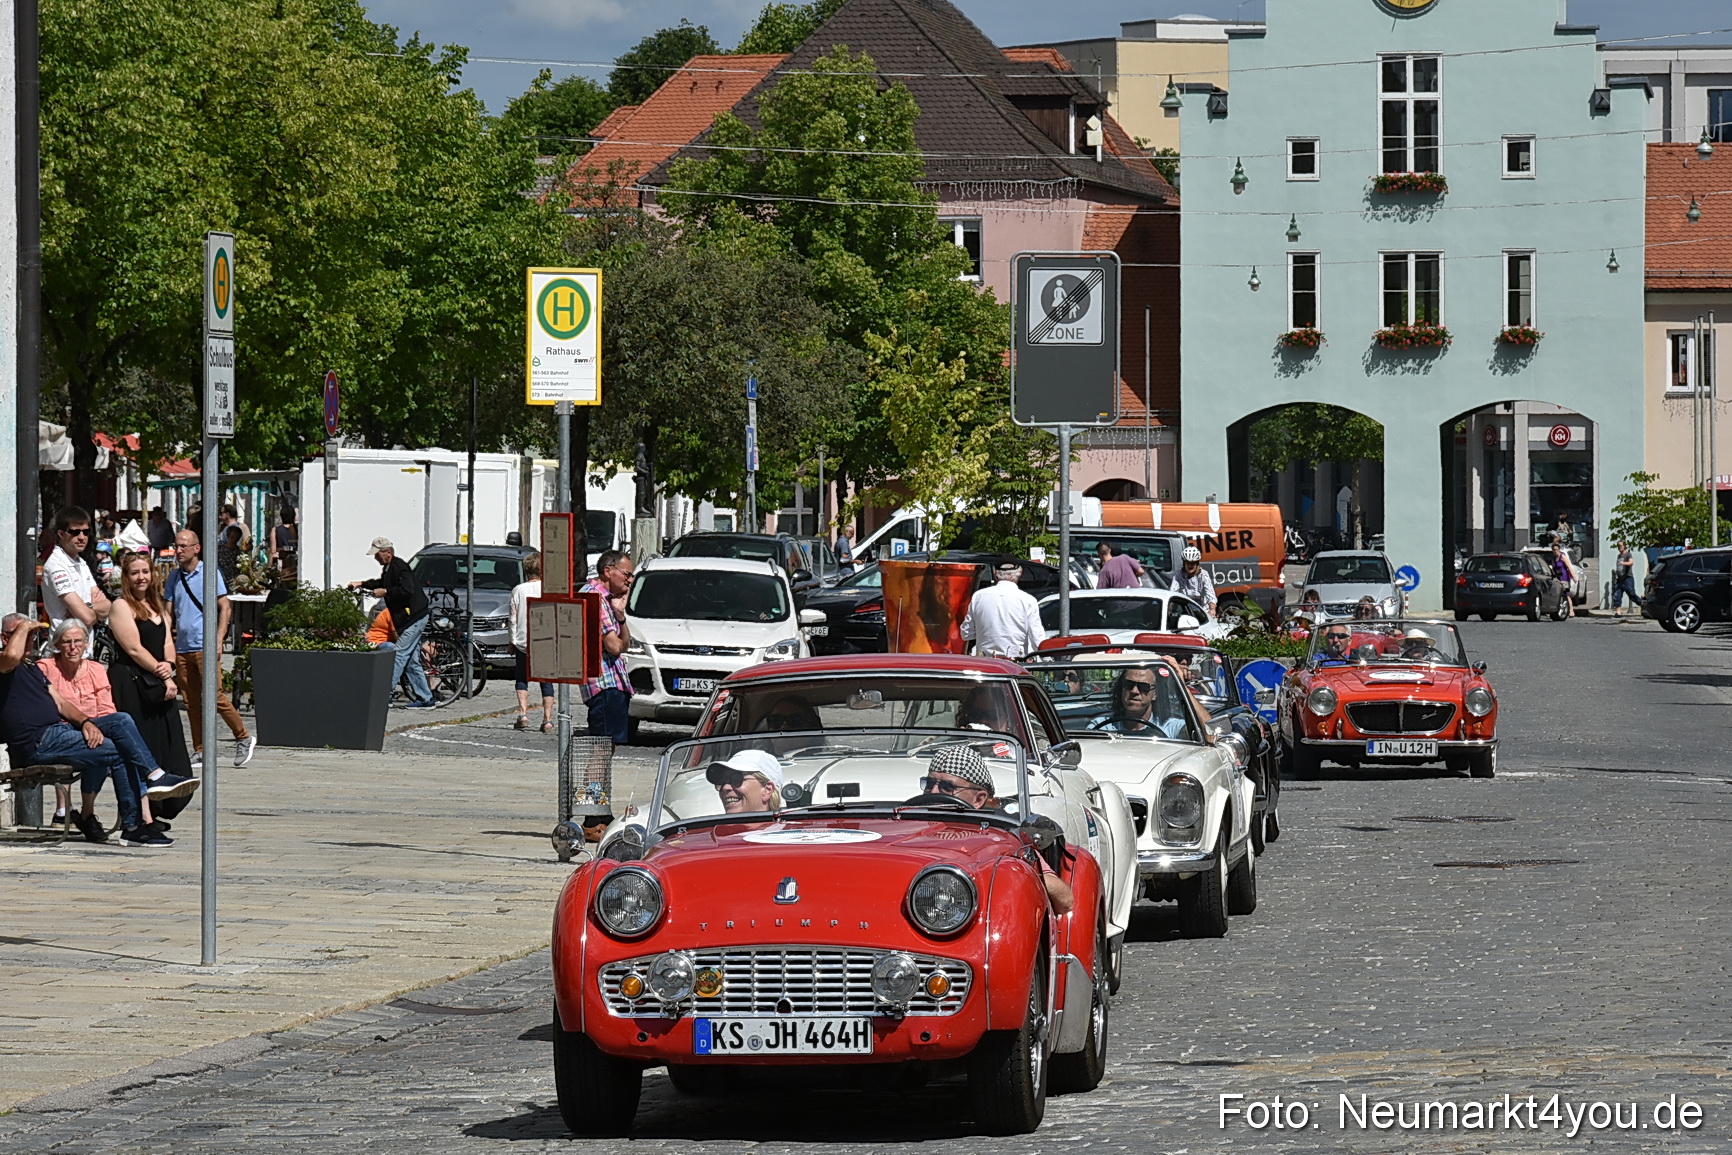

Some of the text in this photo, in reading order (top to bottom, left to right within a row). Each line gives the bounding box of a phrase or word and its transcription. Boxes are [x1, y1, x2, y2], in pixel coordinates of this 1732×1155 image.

[553, 291, 575, 326] H
[1046, 327, 1085, 340] ZONE
[209, 345, 232, 368] Schulbus
[545, 346, 581, 356] Rathaus
[1554, 433, 1566, 441] KH
[1377, 742, 1433, 754] IN U 12H
[700, 918, 869, 932] TRIUMPH
[711, 1021, 744, 1050] KS
[765, 1021, 798, 1049] JH
[804, 1021, 869, 1049] 464H
